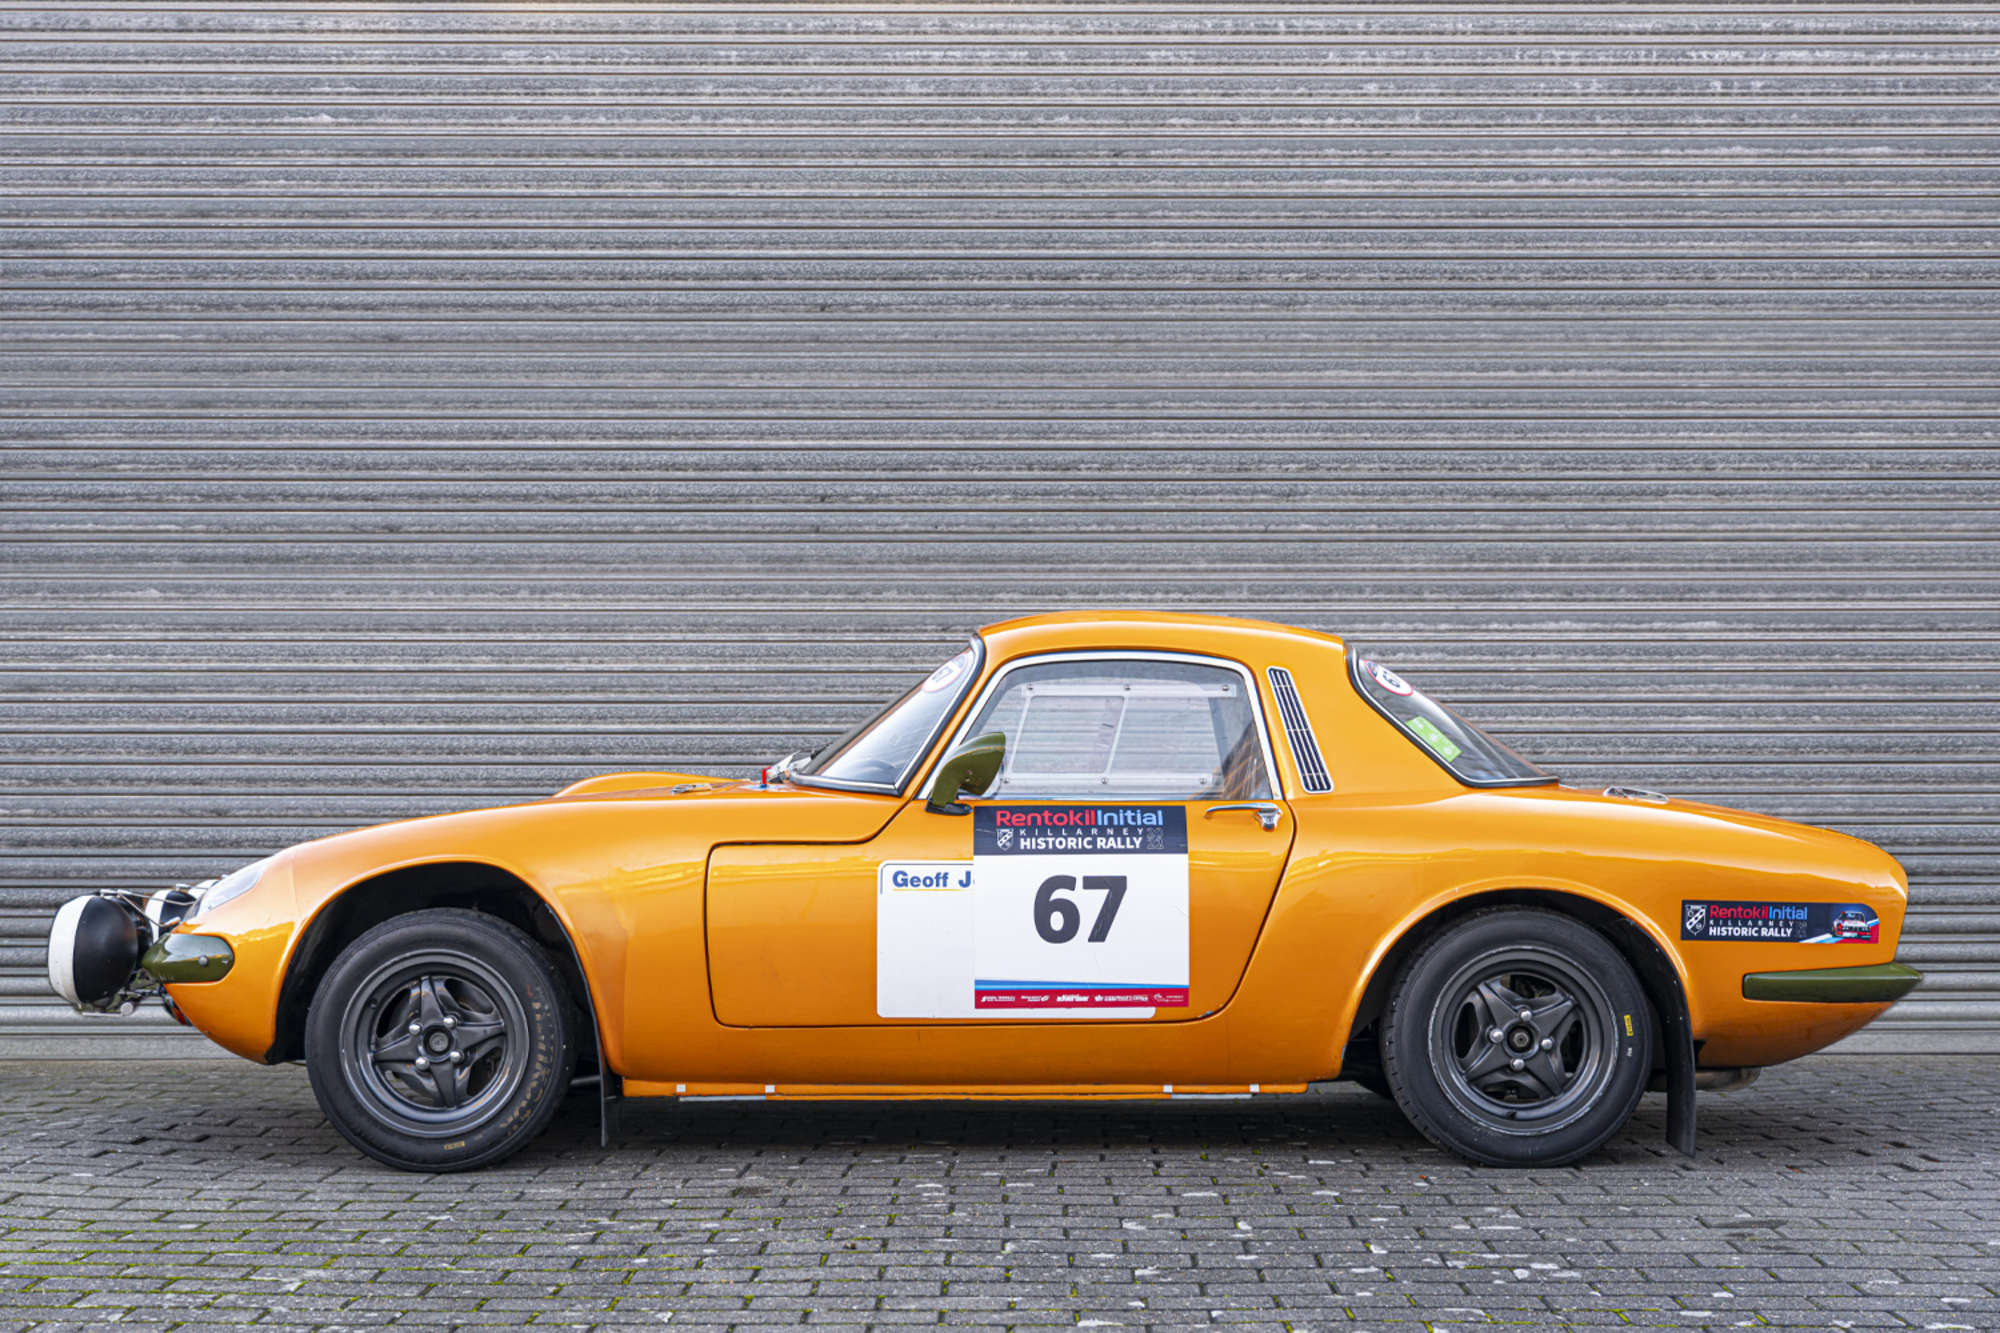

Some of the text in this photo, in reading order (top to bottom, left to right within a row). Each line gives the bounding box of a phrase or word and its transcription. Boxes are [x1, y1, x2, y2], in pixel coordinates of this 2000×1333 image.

[1019, 828, 1144, 836] KILLARNEY
[1019, 837, 1093, 850] HISTORIC
[1096, 837, 1143, 849] RALLY
[892, 870, 975, 888] Geoff J
[1033, 874, 1128, 944] 67
[1709, 927, 1759, 937] HISTORIC
[1760, 927, 1793, 937] RALLY
